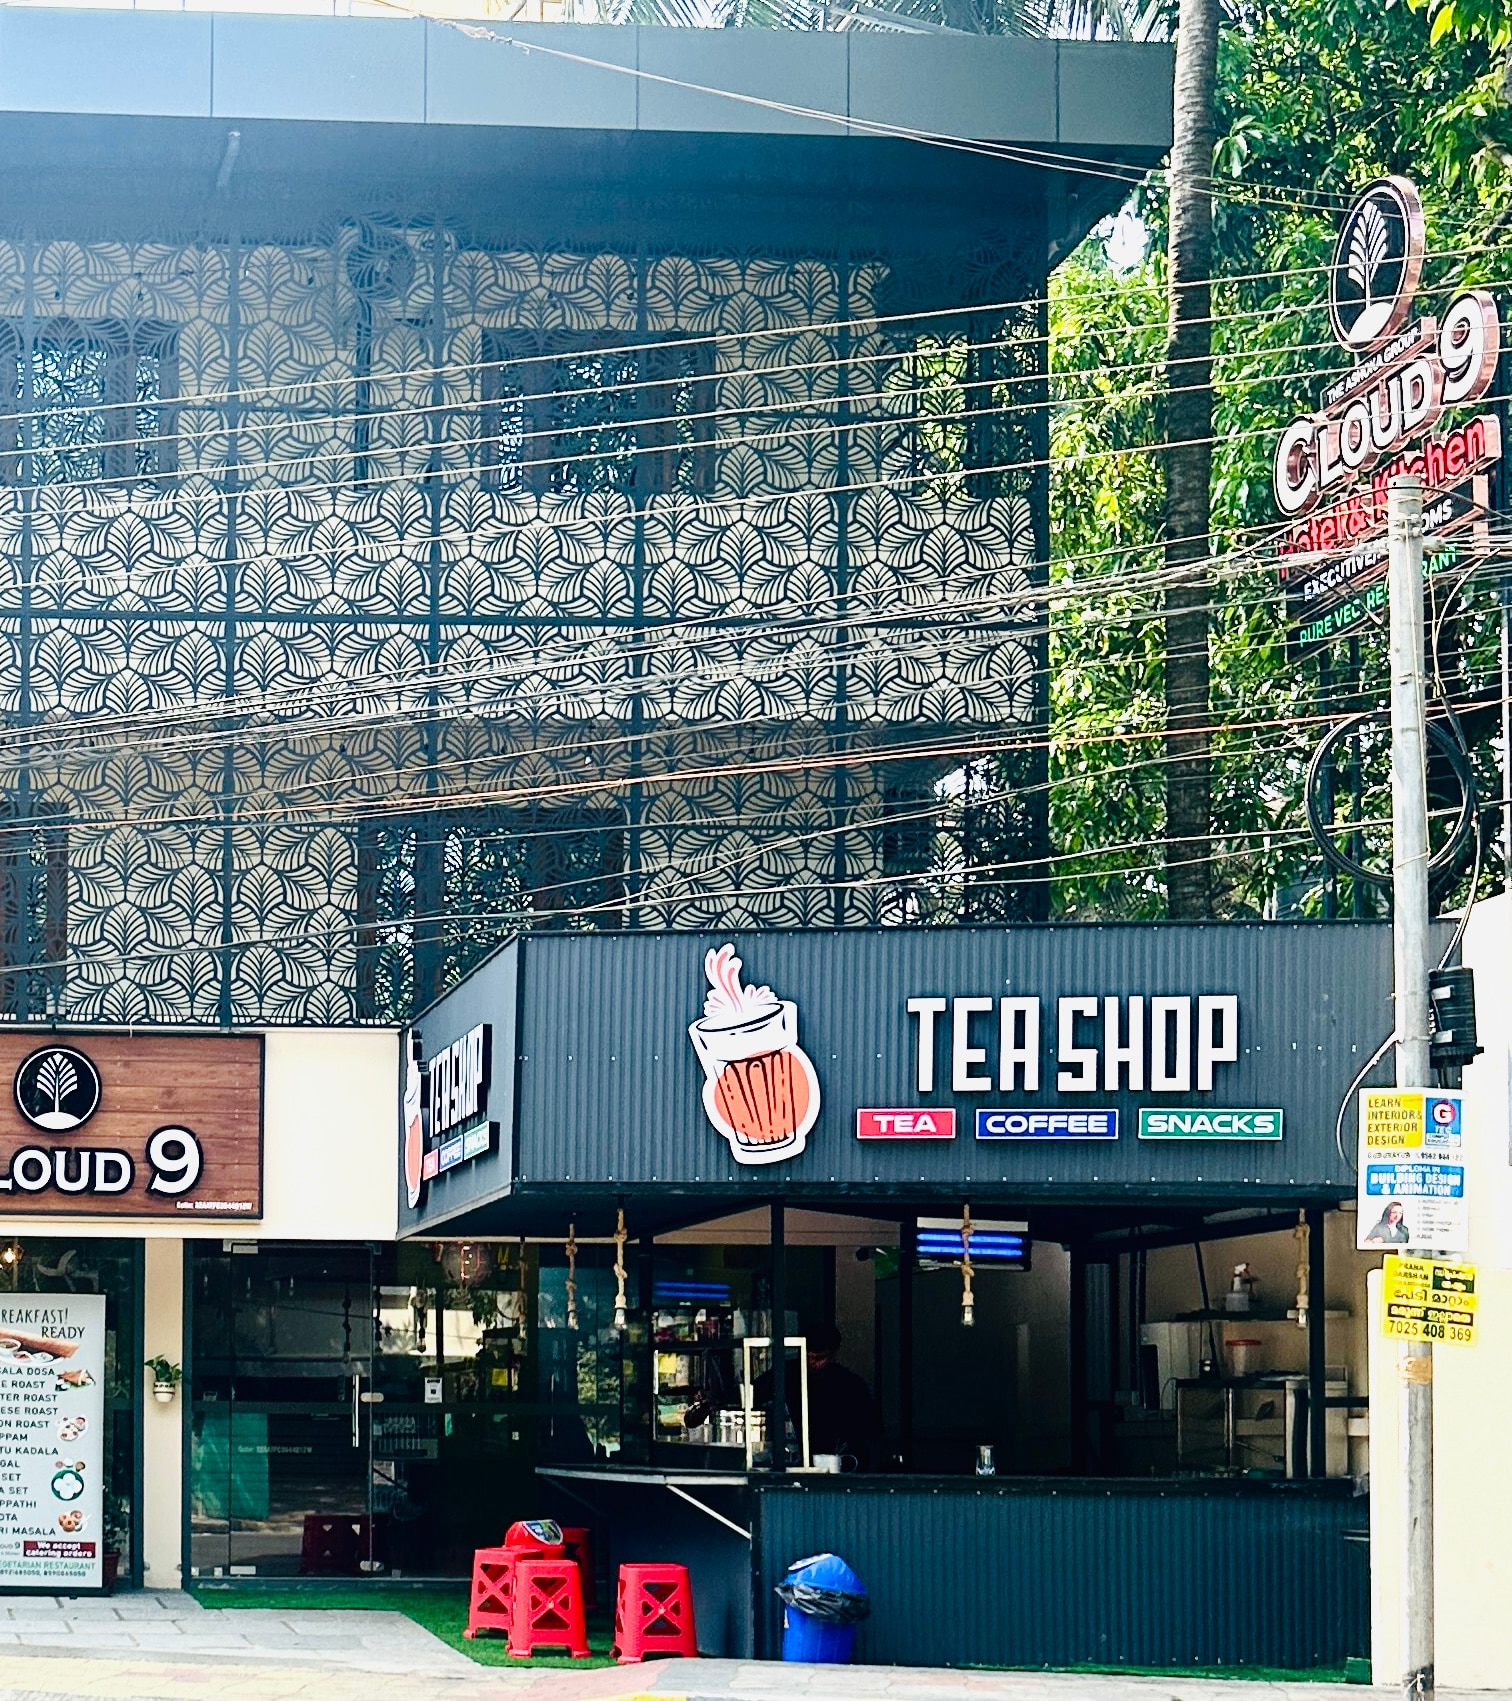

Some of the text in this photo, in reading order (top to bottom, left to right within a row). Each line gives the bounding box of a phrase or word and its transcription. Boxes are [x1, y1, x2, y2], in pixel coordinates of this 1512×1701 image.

[1327, 380, 1345, 404] THE
[1274, 294, 1485, 514] CLOUD 9
[1299, 613, 1332, 647] PURE
[908, 994, 1238, 1092] TEA SHOP
[429, 1023, 484, 1138] TEA SHOP
[1368, 1098, 1401, 1108] LEARN
[1433, 1102, 1455, 1125] G
[873, 1114, 937, 1133] TEA
[986, 1114, 1108, 1133] COFFEE
[1147, 1114, 1275, 1133] SNACKS
[1368, 1123, 1418, 1133] EXTERIOR
[1368, 1135, 1405, 1145] DESIGN
[148, 1129, 201, 1194] 9
[1370, 1173, 1461, 1186] BUILDING DESIGN
[1393, 1184, 1451, 1196] ANIMATION
[41, 1326, 85, 1339] READY
[1389, 1320, 1472, 1341] 7025 408 369
[27, 1368, 55, 1376] DOSA
[11, 1380, 45, 1389] ROAST
[24, 1394, 58, 1402] ROAST
[24, 1407, 58, 1415] ROAST
[15, 1420, 50, 1428] ROAST
[15, 1447, 59, 1455] KADALA
[1, 1473, 22, 1481] SET
[9, 1487, 29, 1495] SET
[12, 1527, 56, 1536] MASALA
[52, 1542, 81, 1550] accept
[26, 1549, 61, 1558] catering
[44, 1561, 96, 1570] RESTAURANT
